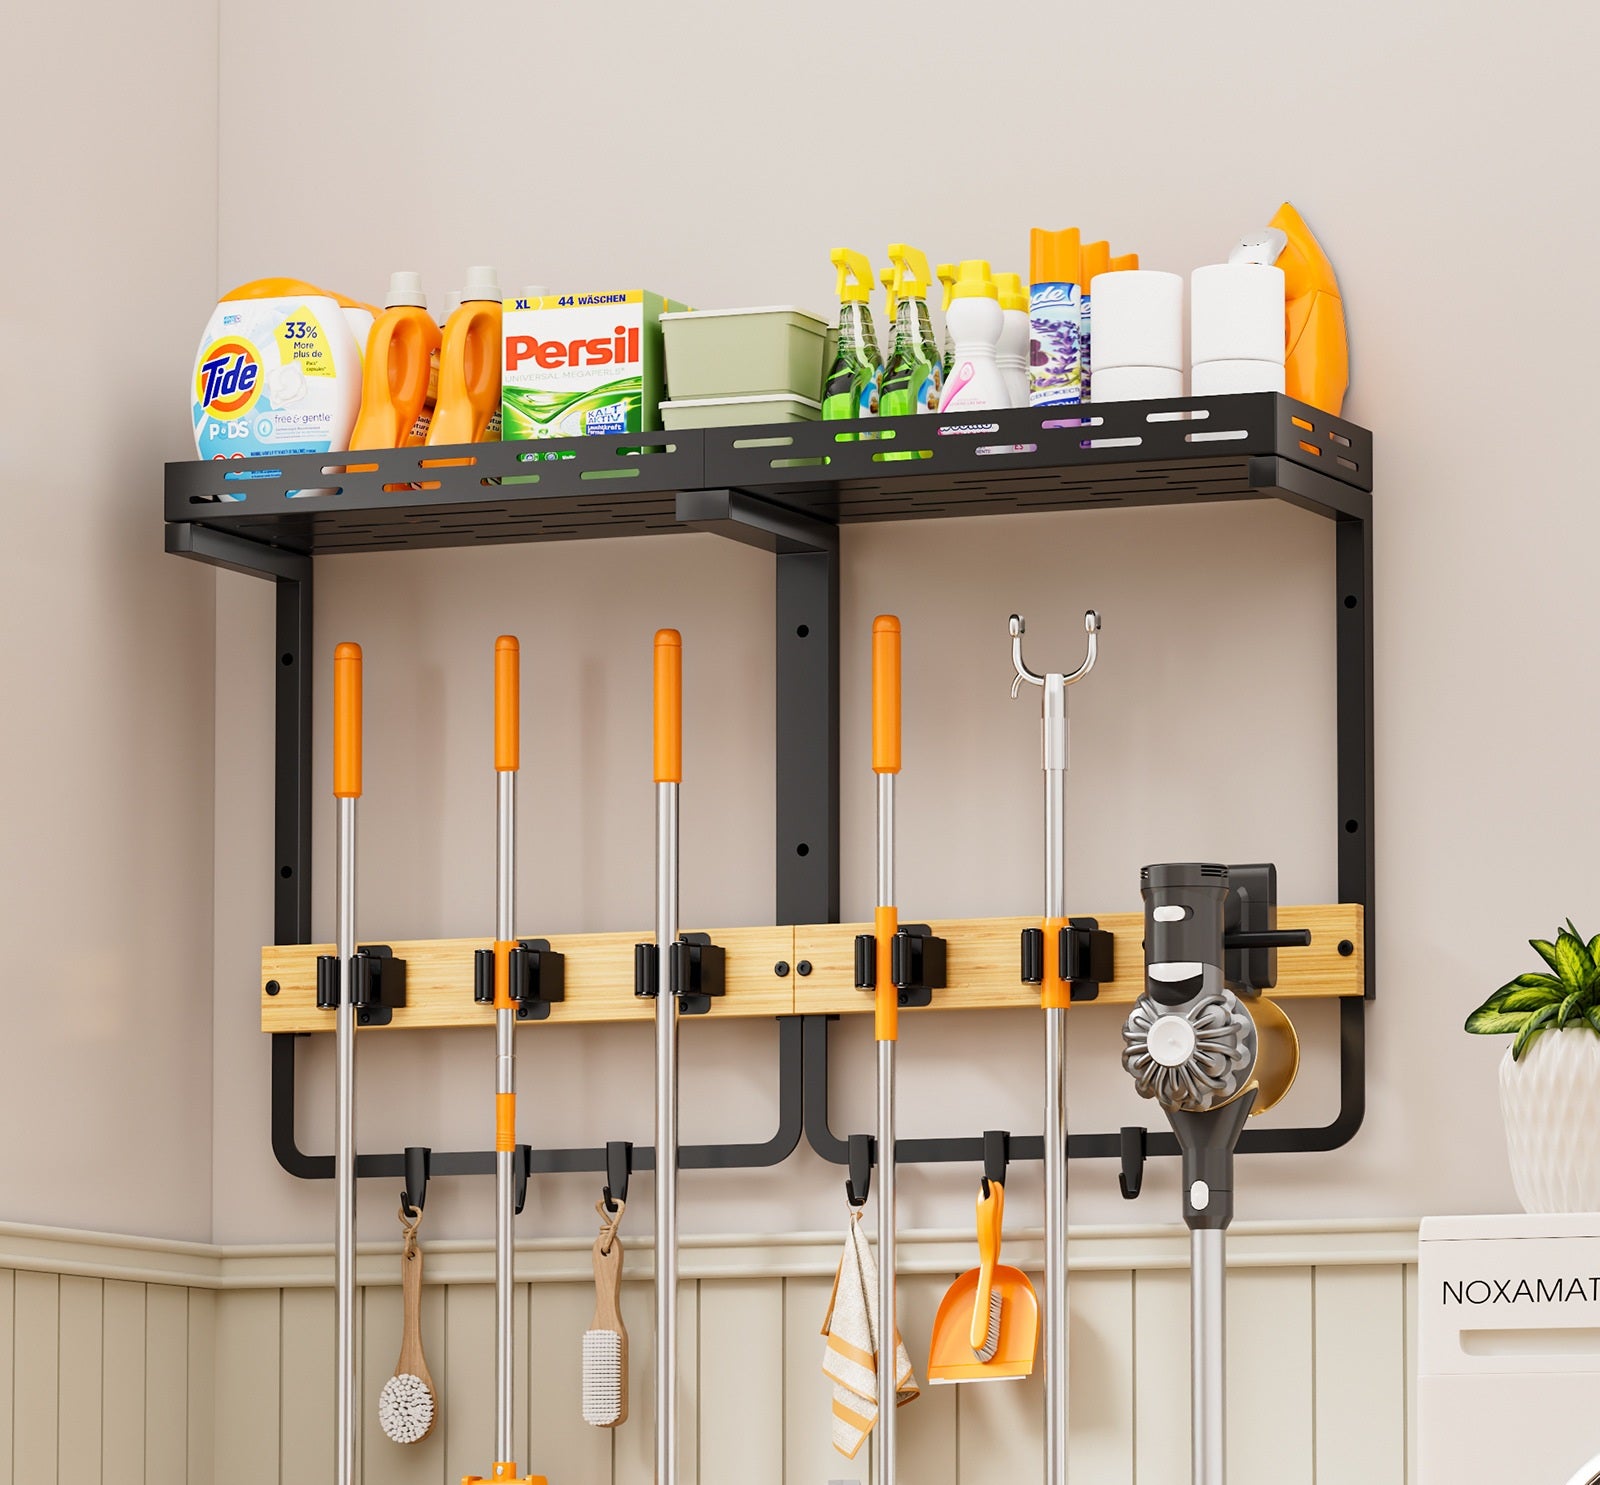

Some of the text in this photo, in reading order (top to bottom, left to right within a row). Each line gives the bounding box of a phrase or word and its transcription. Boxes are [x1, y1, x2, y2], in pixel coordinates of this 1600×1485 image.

[515, 294, 626, 310] XL 44 WÄSCHEN
[284, 321, 318, 339] 33%
[293, 341, 314, 350] More
[505, 325, 640, 371] Persil
[293, 350, 323, 360] plus de
[201, 352, 258, 409] Tide
[504, 374, 559, 384] UNIVERSAL
[274, 414, 292, 424] free
[302, 412, 331, 424] gentle
[587, 403, 622, 418] KALT
[587, 413, 622, 424] AKTIV
[1442, 1277, 1600, 1305] NOXAMAT
